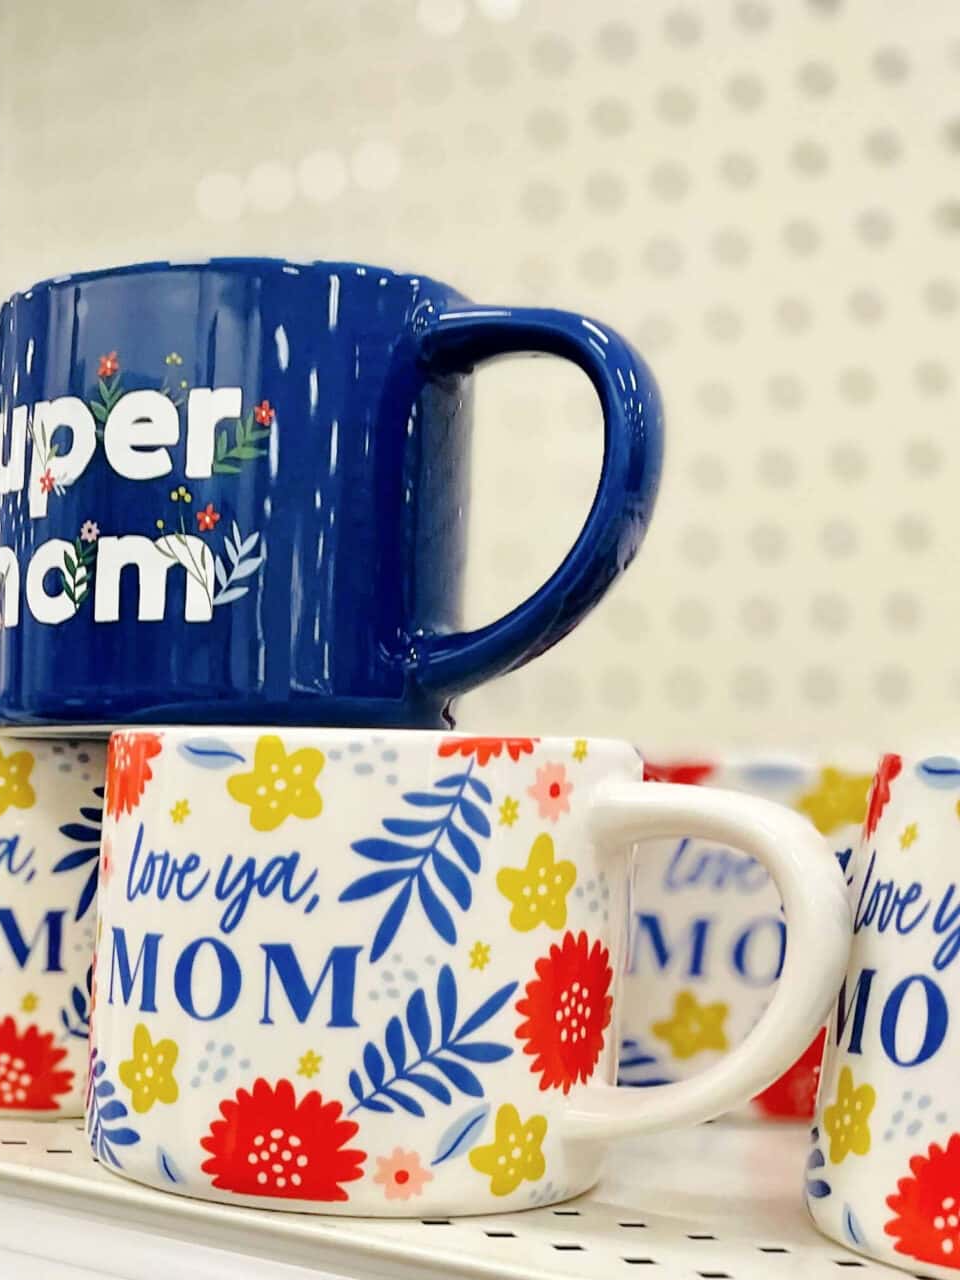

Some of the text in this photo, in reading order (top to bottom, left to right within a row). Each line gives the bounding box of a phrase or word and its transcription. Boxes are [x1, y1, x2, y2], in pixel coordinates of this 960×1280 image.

[127, 821, 320, 934] love ya,
[853, 849, 931, 935] love
[108, 926, 364, 1029] MOM
